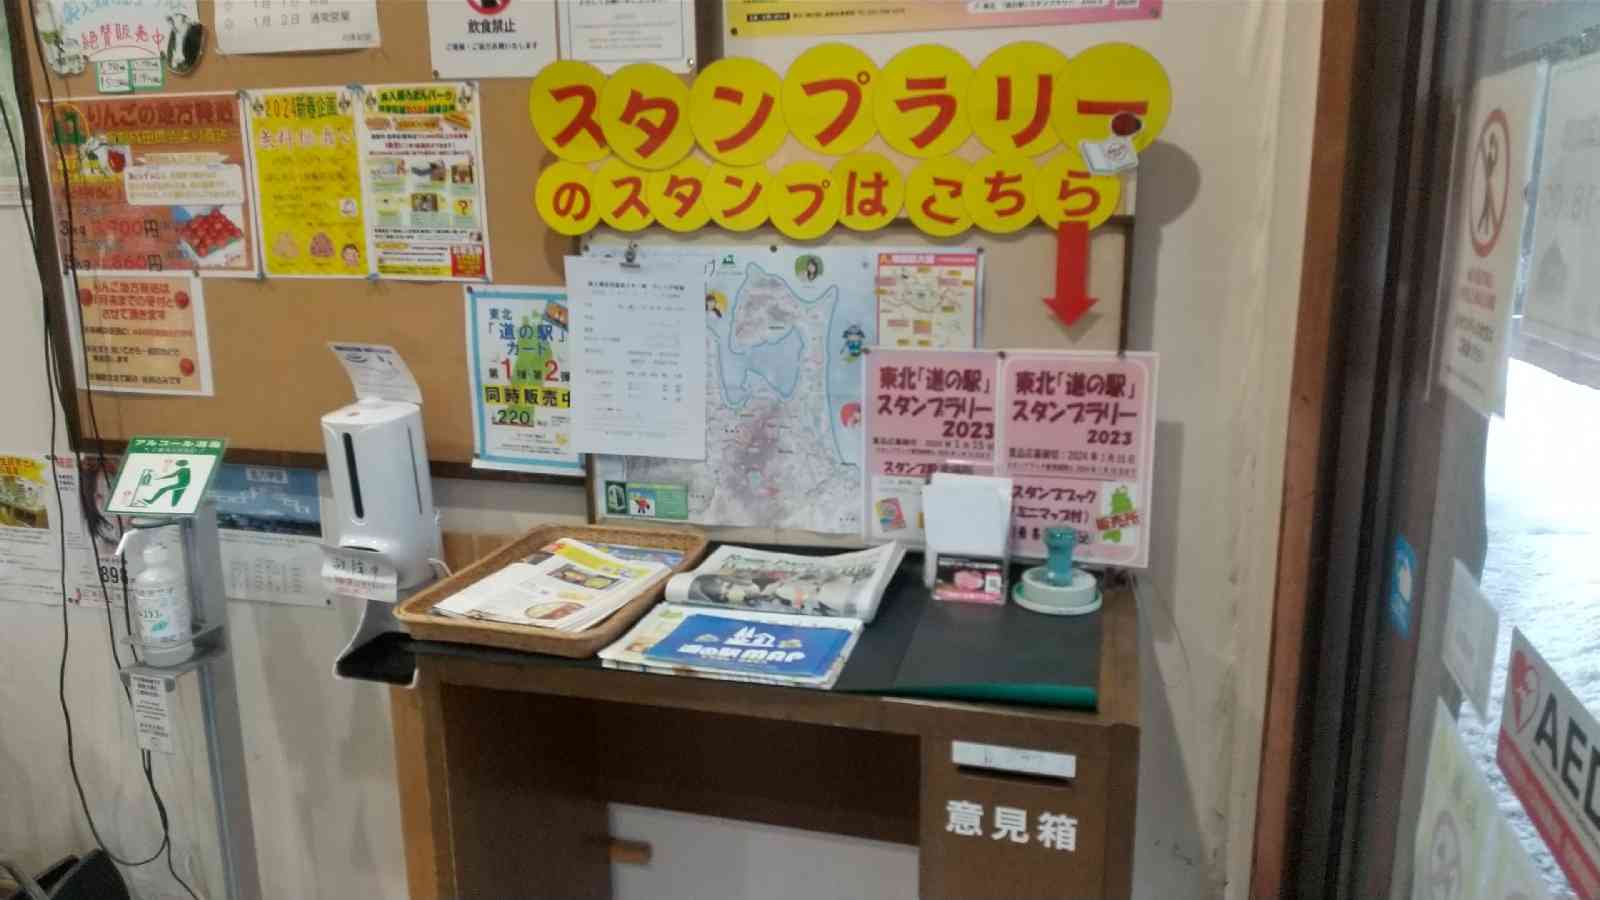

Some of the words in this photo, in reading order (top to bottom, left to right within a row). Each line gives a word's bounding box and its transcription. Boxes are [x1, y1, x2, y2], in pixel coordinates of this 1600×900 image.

[467, 18, 517, 34] 飲食禁止
[548, 71, 1149, 160] スタンプラリー
[552, 169, 1102, 227] のスタンプはこちら
[489, 308, 512, 320] 東北
[488, 322, 567, 343] 「道の駅」
[880, 366, 990, 394] 東北「道の駅」
[1016, 371, 1135, 399] 東北「道の駅」
[877, 394, 993, 419] スタンプラリー
[1012, 401, 1138, 425] スタンプラリー
[941, 420, 994, 440] 2023
[1087, 429, 1133, 446] 2023
[945, 800, 1078, 852] 意見箱
